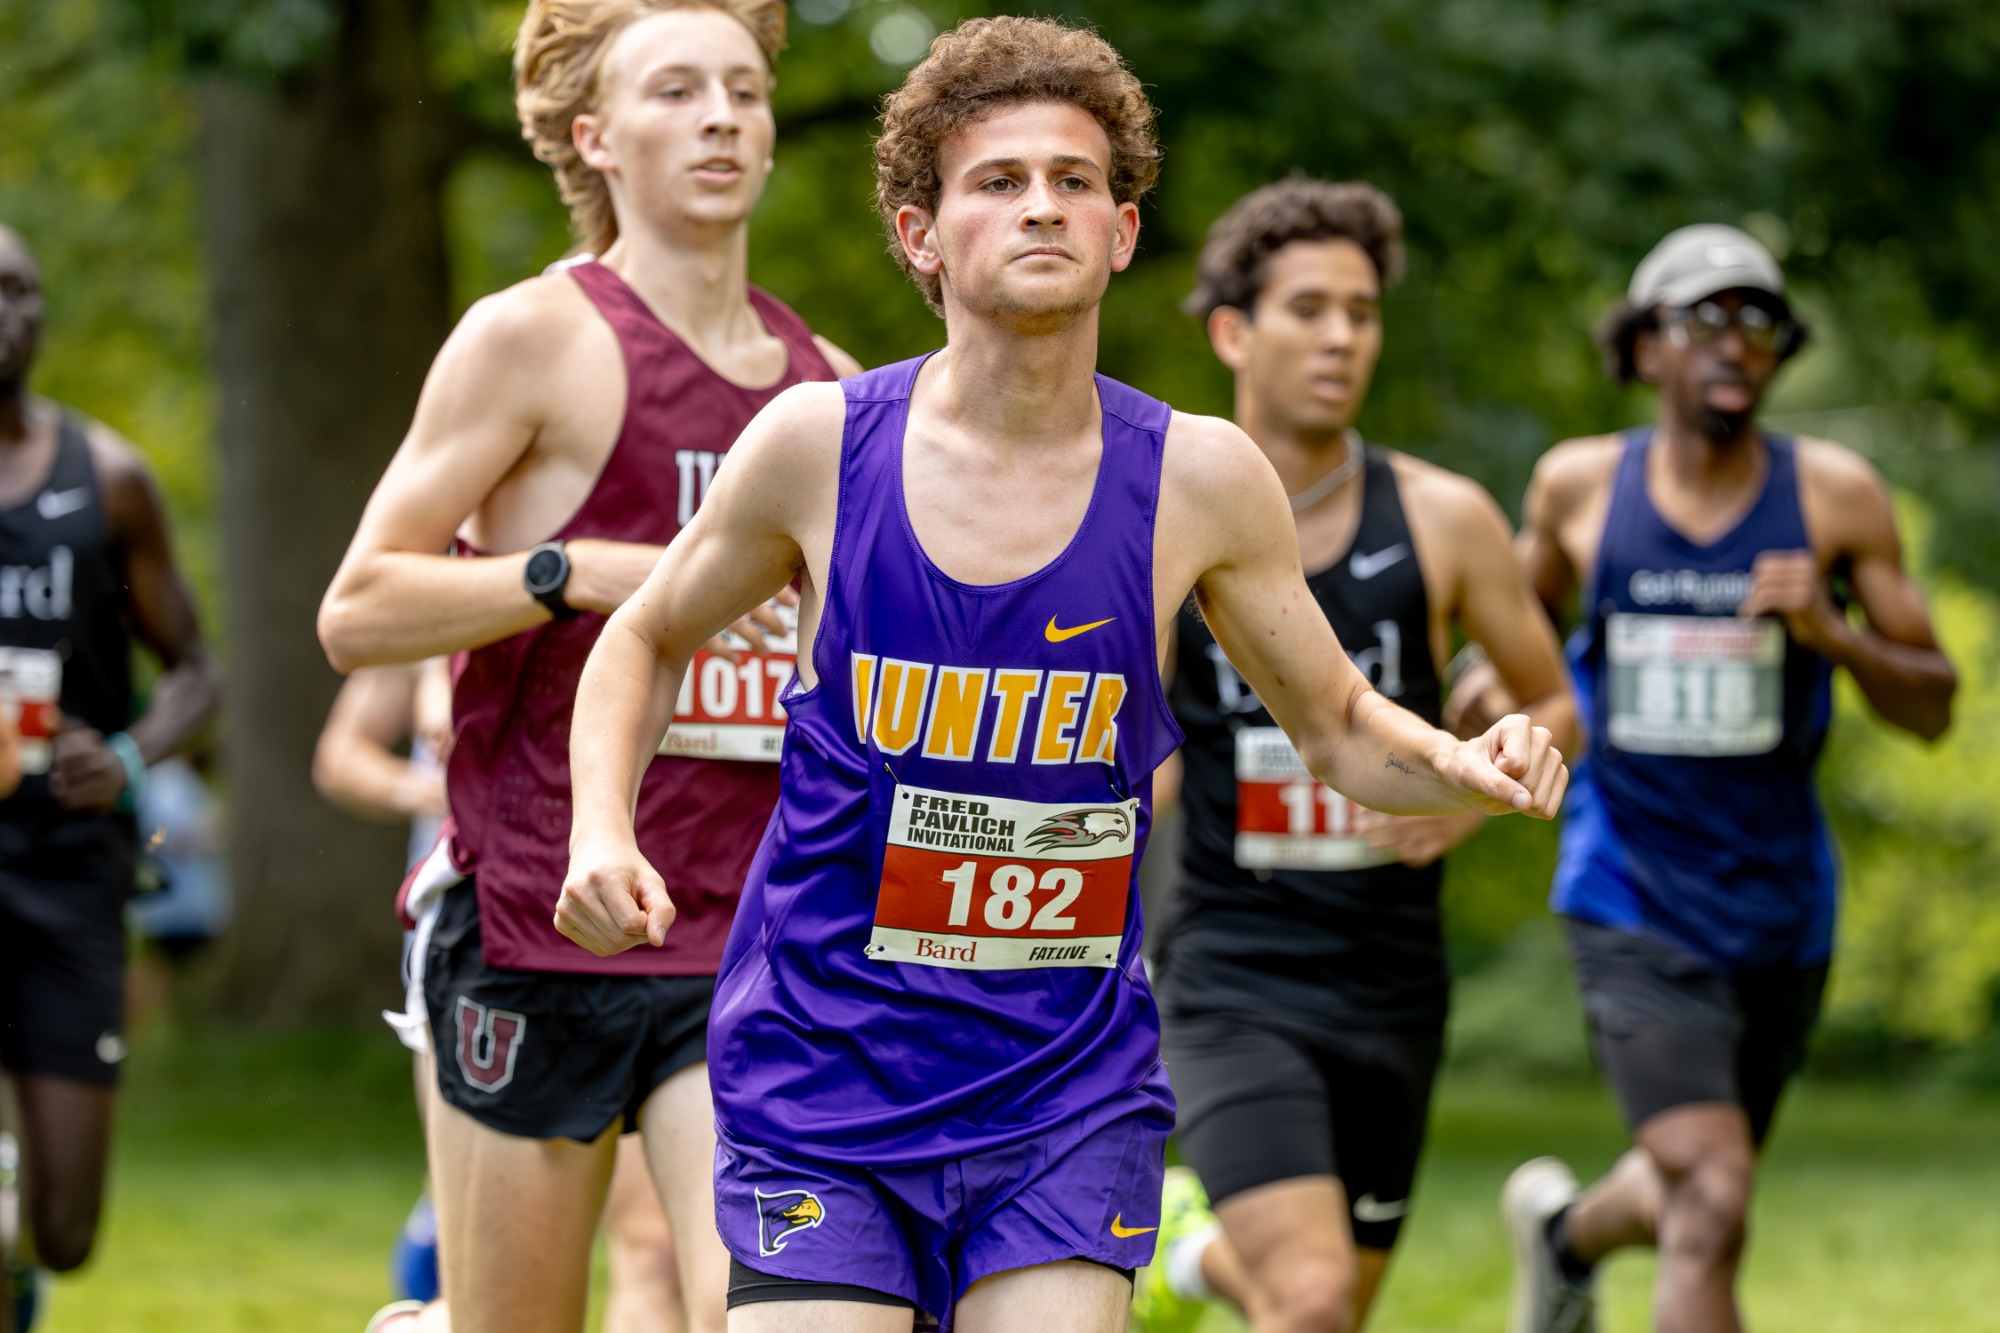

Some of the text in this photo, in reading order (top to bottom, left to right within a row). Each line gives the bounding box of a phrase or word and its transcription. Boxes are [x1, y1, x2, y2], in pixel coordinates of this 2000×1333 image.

[912, 793, 989, 816] FRED
[909, 808, 1016, 837] PAVLICH
[907, 826, 1015, 853] INVITATIONAL
[942, 860, 1084, 931] 182
[914, 937, 1090, 963] Bard FAT.LIVE
[455, 995, 527, 1094] U
